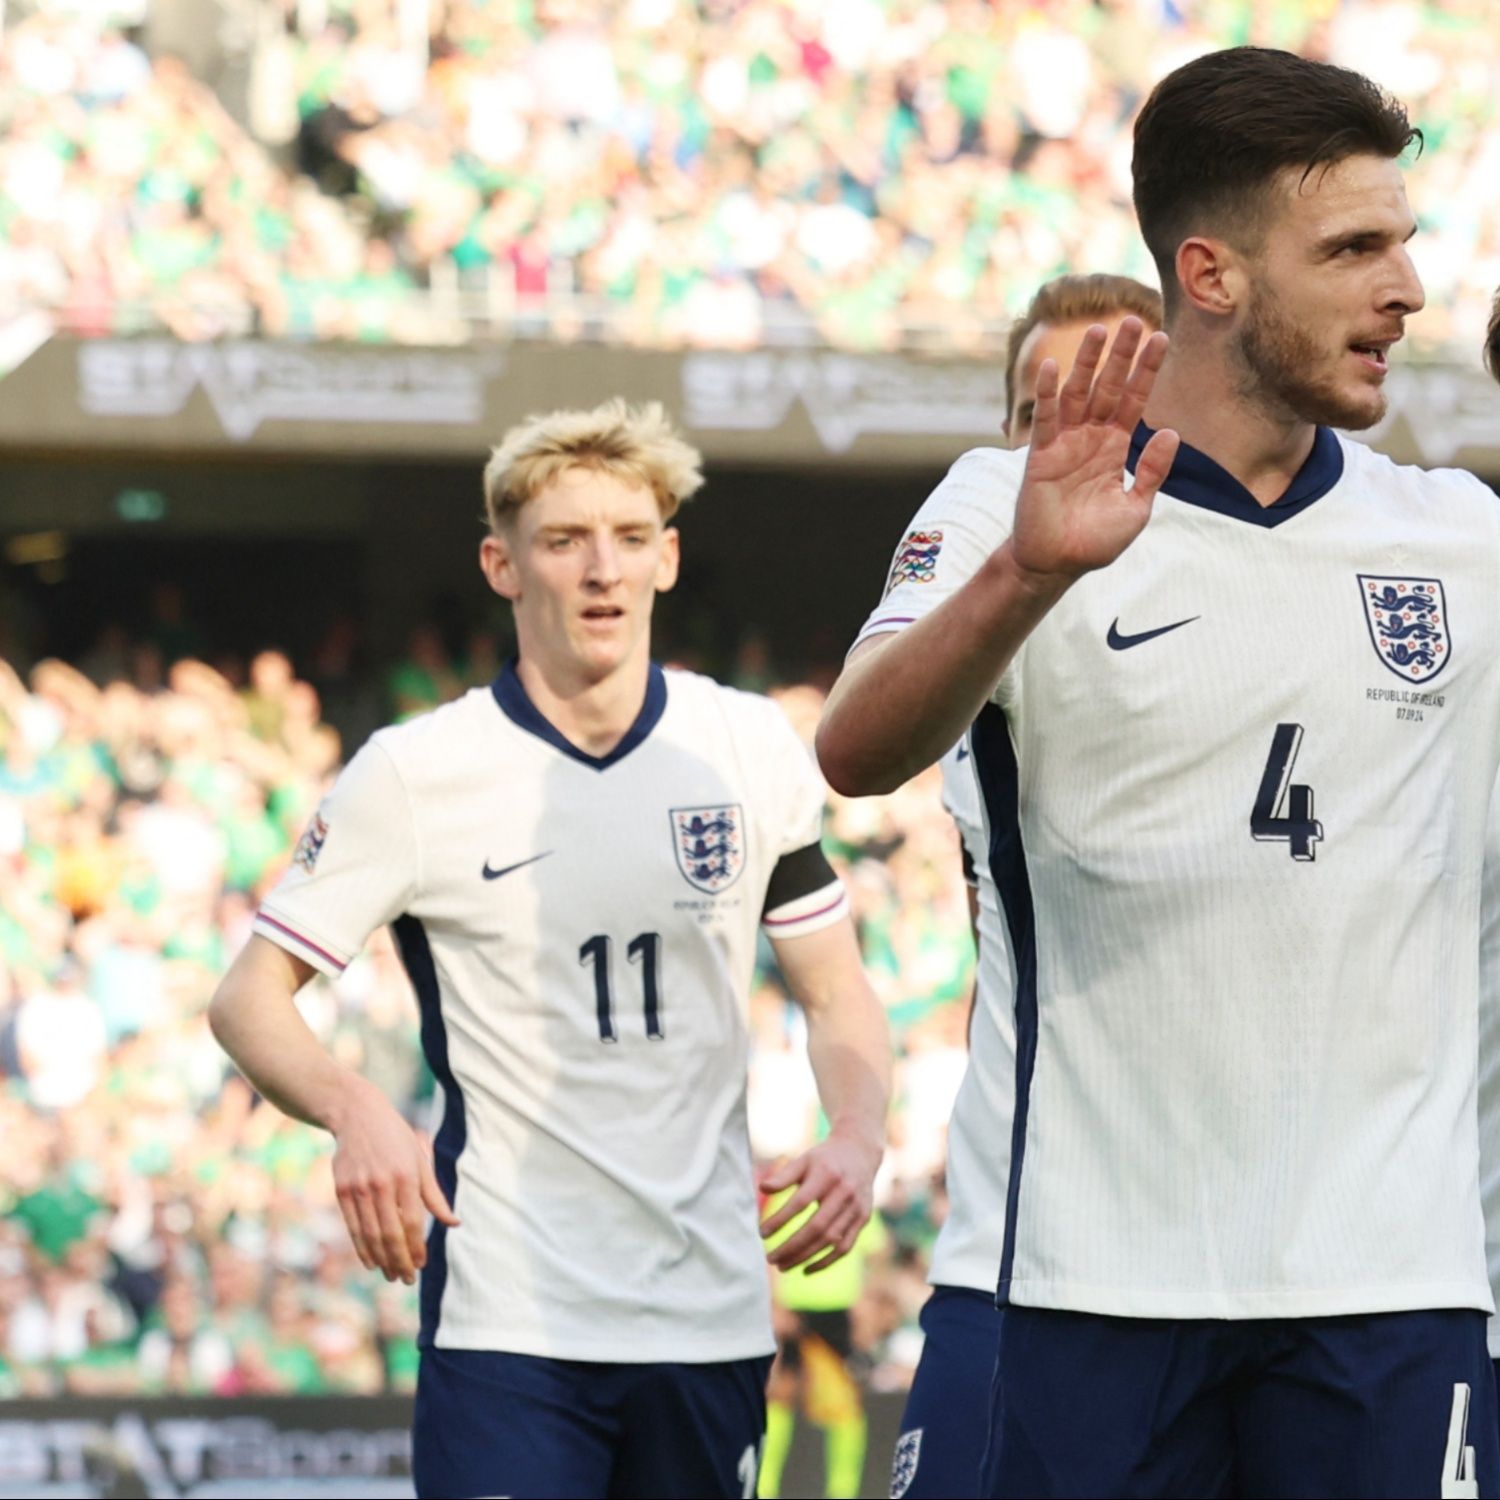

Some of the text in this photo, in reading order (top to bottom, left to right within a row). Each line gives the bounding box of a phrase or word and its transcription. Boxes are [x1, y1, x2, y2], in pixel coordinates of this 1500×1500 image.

[1366, 688, 1410, 703] REPUBLIC
[1410, 692, 1420, 704] OF
[1250, 723, 1324, 861] 4
[579, 931, 664, 1044] 11
[1441, 1383, 1479, 1498] 4
